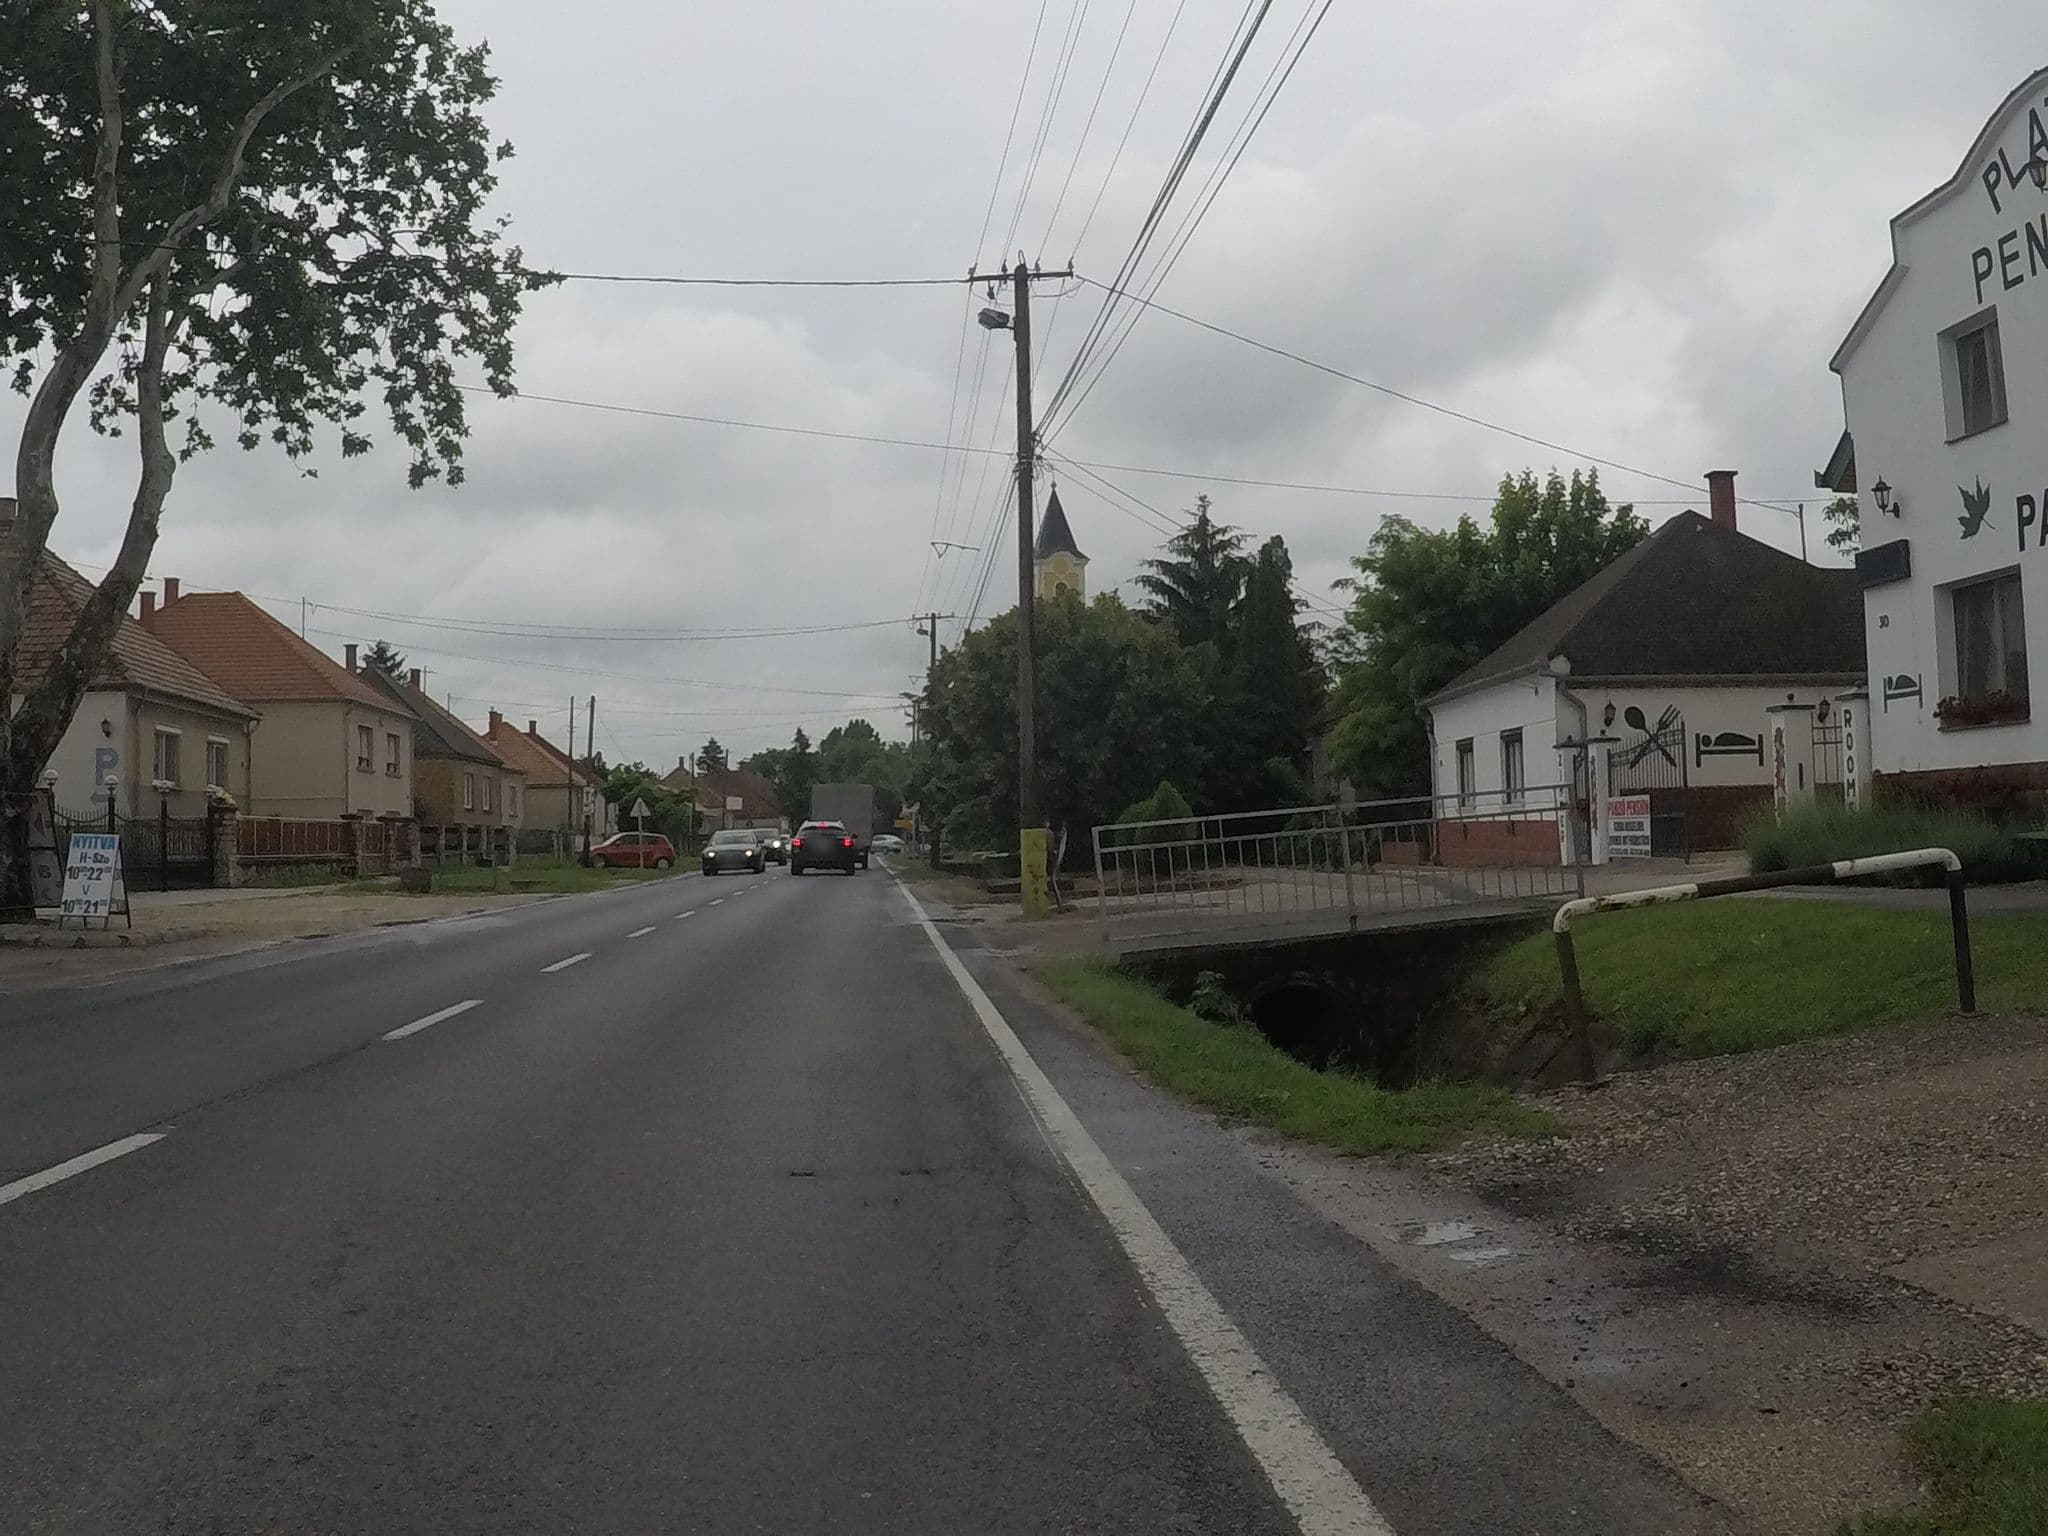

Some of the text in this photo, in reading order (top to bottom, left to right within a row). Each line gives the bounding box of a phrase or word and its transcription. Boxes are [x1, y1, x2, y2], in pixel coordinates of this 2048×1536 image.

[1982, 97, 2048, 215] PLA
[95, 748, 119, 785] P
[71, 836, 116, 849] NYITVA
[82, 884, 91, 895] V
